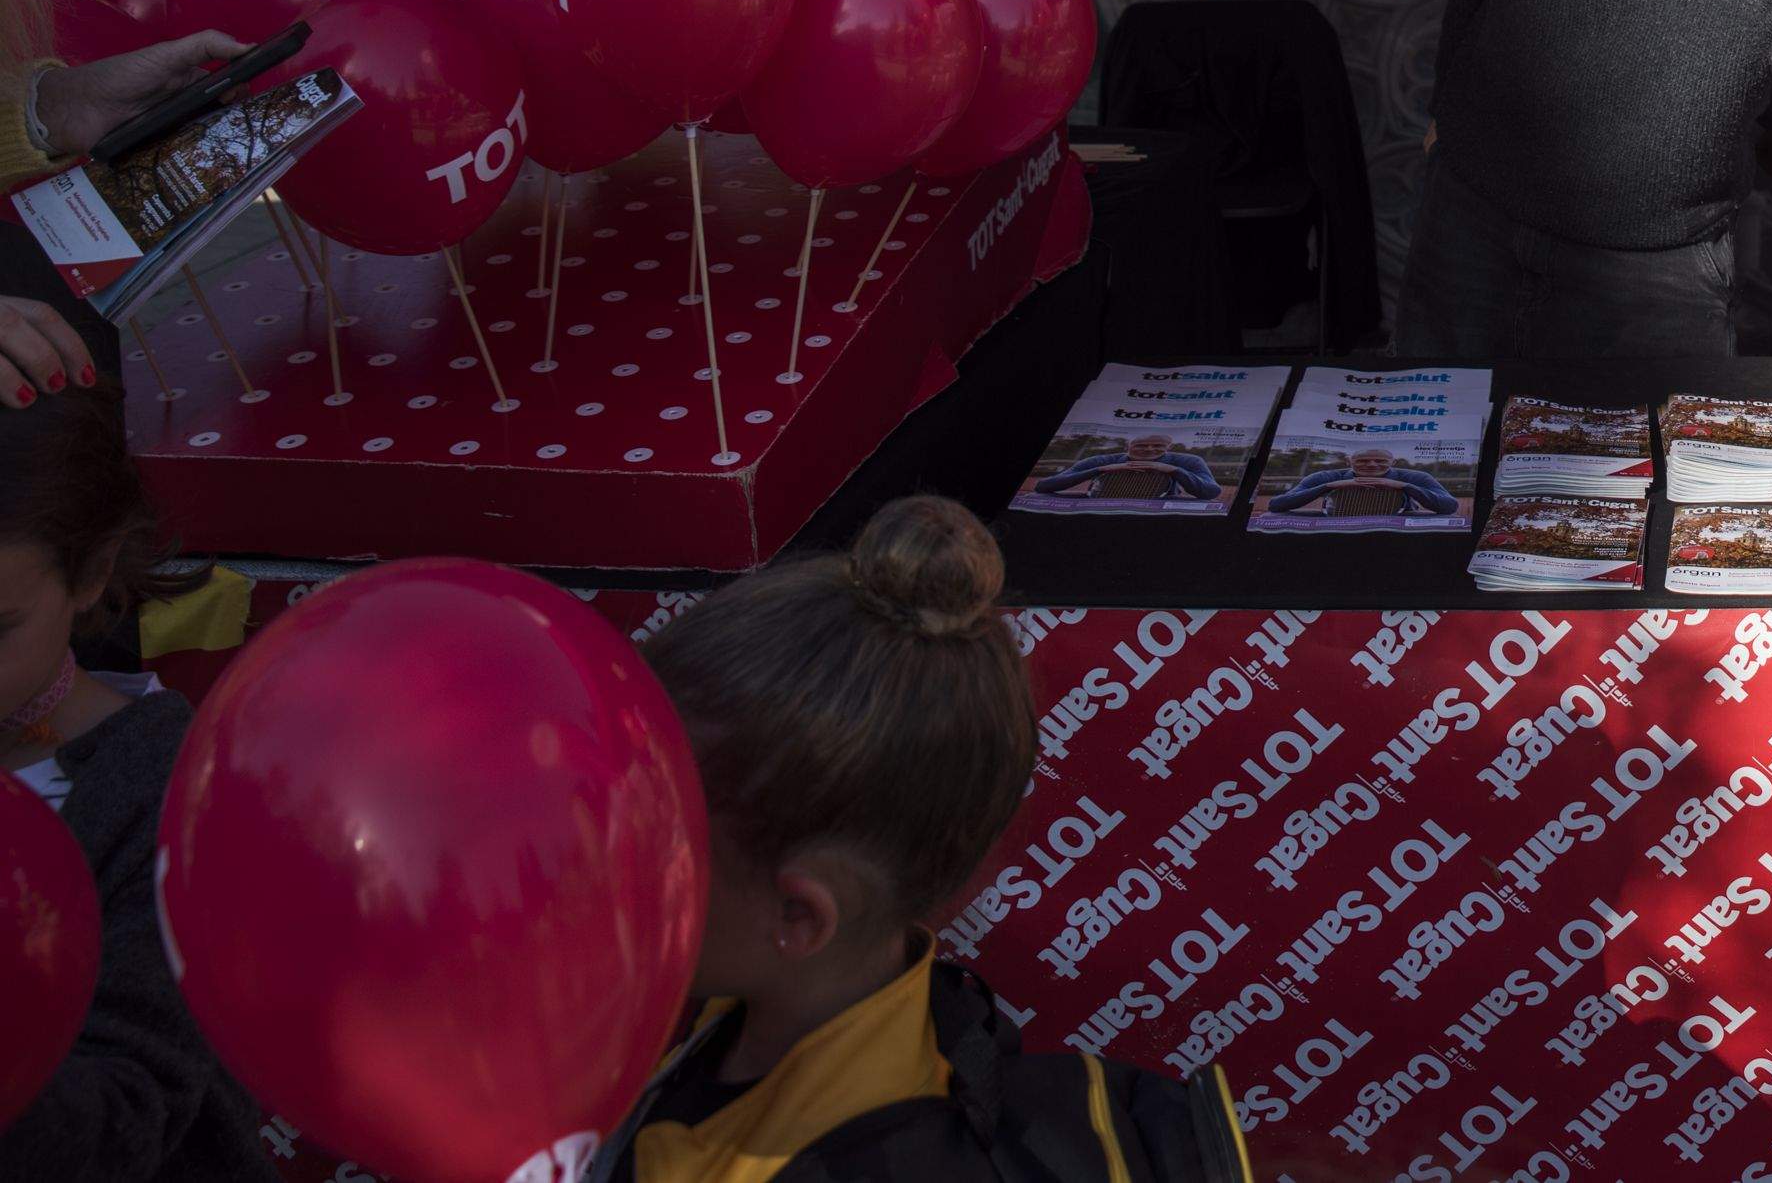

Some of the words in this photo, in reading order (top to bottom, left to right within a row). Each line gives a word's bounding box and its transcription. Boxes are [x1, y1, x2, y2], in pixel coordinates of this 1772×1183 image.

[295, 72, 332, 108] Cugat
[426, 89, 528, 204] TOT
[966, 222, 996, 272] TOT
[994, 188, 1025, 234] Sant
[1024, 130, 1062, 192] Cugat
[1112, 406, 1226, 421] totsalut
[1126, 387, 1236, 401] totsalut
[1142, 370, 1248, 382] totsalut
[1337, 402, 1449, 416] totsalut
[1345, 372, 1451, 385] totsalut
[1513, 396, 1550, 407] TOT
[1550, 401, 1586, 414] Sant
[1592, 406, 1638, 416] Cugat
[1673, 394, 1710, 403] TOT
[1710, 397, 1747, 407] Sant
[1323, 417, 1439, 433] totsalut
[1503, 496, 1541, 506] TOT
[1541, 497, 1582, 508] Sant
[1587, 500, 1638, 510] Cugat
[1681, 506, 1720, 516] TOT
[1719, 506, 1761, 516] Sant
[1241, 708, 1344, 801] TOT
[1371, 688, 1480, 783] Sant
[1591, 725, 1697, 821] TOT
[1026, 796, 1126, 887] TOT
[1153, 781, 1258, 869] Sant
[1254, 783, 1380, 891] Cugat
[1368, 819, 1471, 912] TOT
[1497, 802, 1605, 892] Sant
[1646, 767, 1772, 877] Cugat
[938, 866, 1042, 959] Sant
[1037, 868, 1161, 979] Cugat
[1276, 891, 1382, 983] Sant
[1379, 892, 1504, 1000] Cugat
[1536, 898, 1638, 987] TOT
[1664, 877, 1770, 963] Sant
[1656, 996, 1756, 1080] TOT
[1565, 1063, 1667, 1149] Sant
